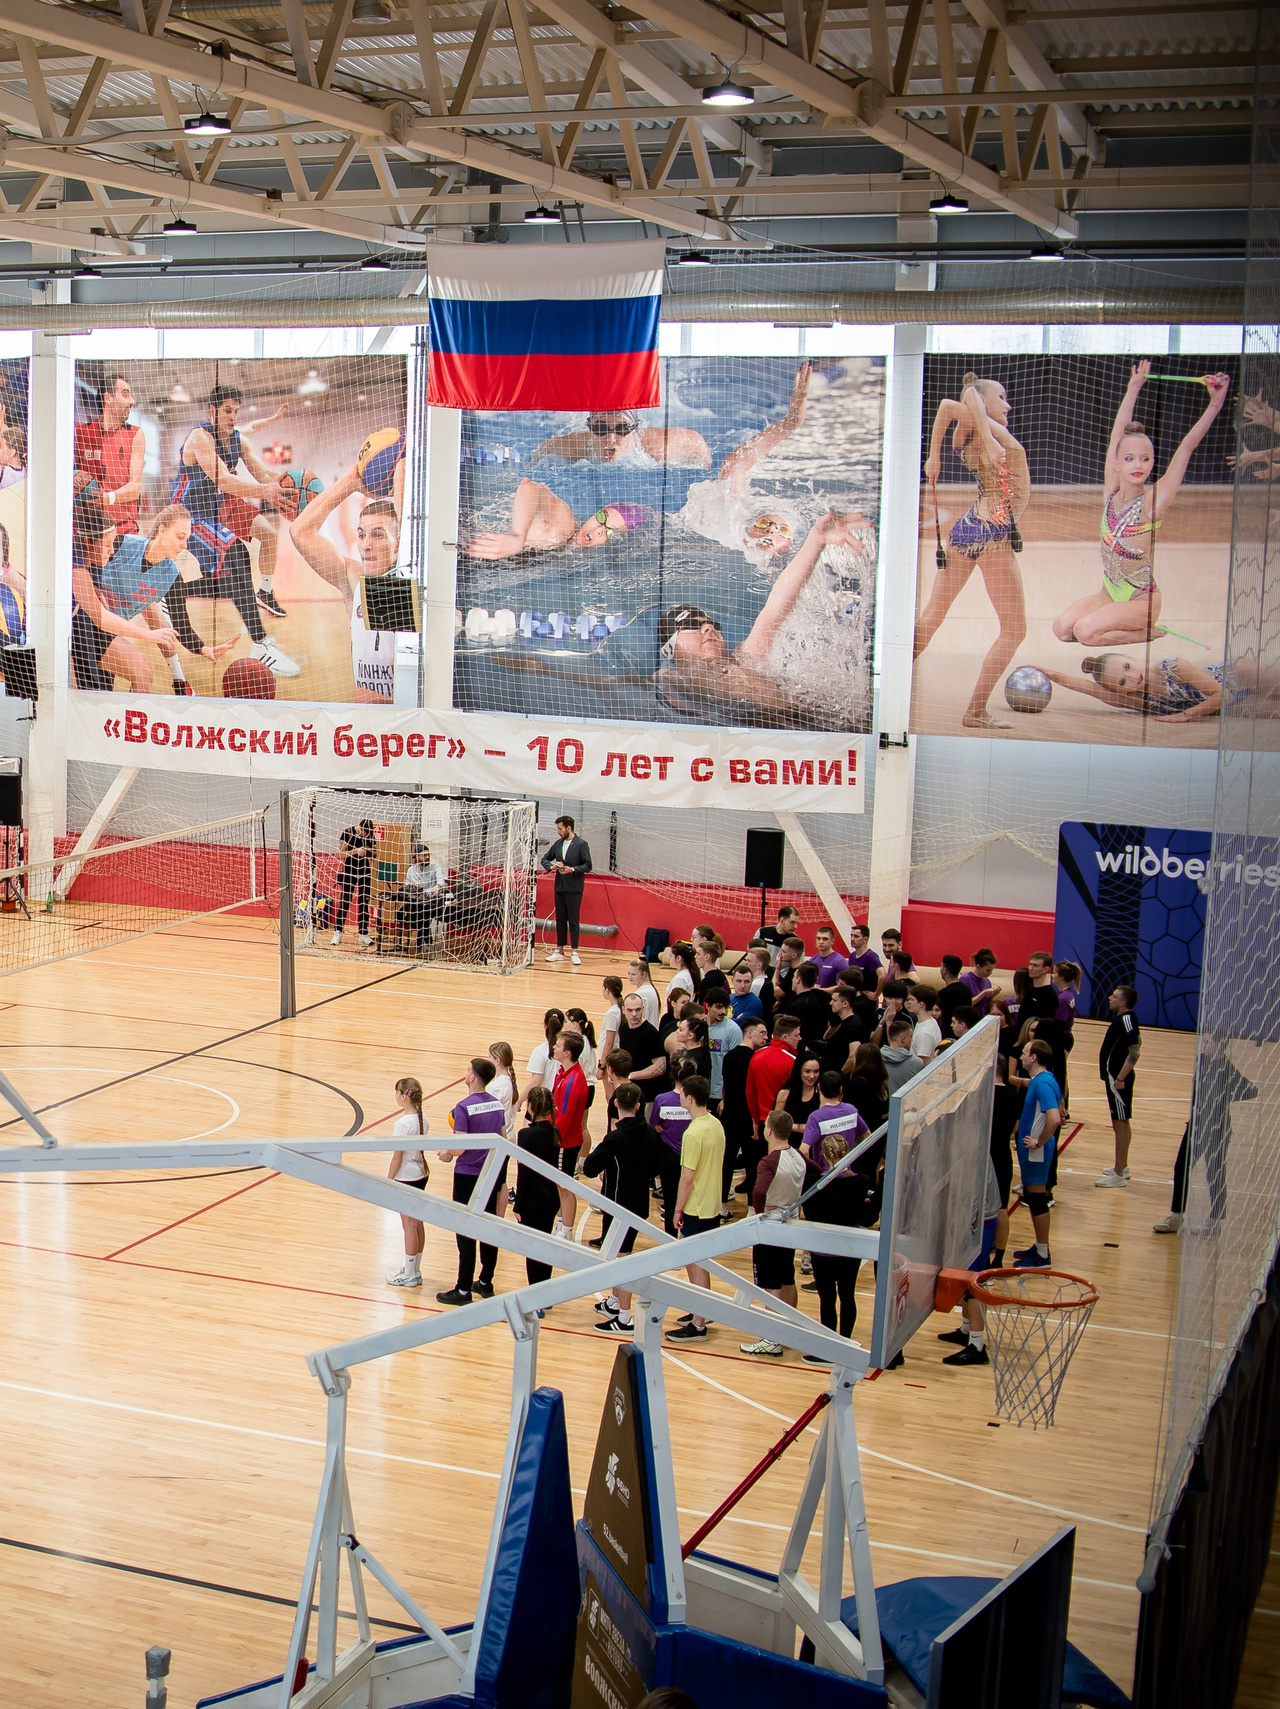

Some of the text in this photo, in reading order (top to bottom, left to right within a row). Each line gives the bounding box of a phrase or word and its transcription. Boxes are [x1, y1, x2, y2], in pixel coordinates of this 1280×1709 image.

[103, 709, 318, 756] «Волжский
[333, 723, 466, 767] берег»
[526, 735, 584, 774] 10
[601, 751, 674, 782] лет
[690, 756, 714, 783] с
[729, 749, 858, 787] вами!
